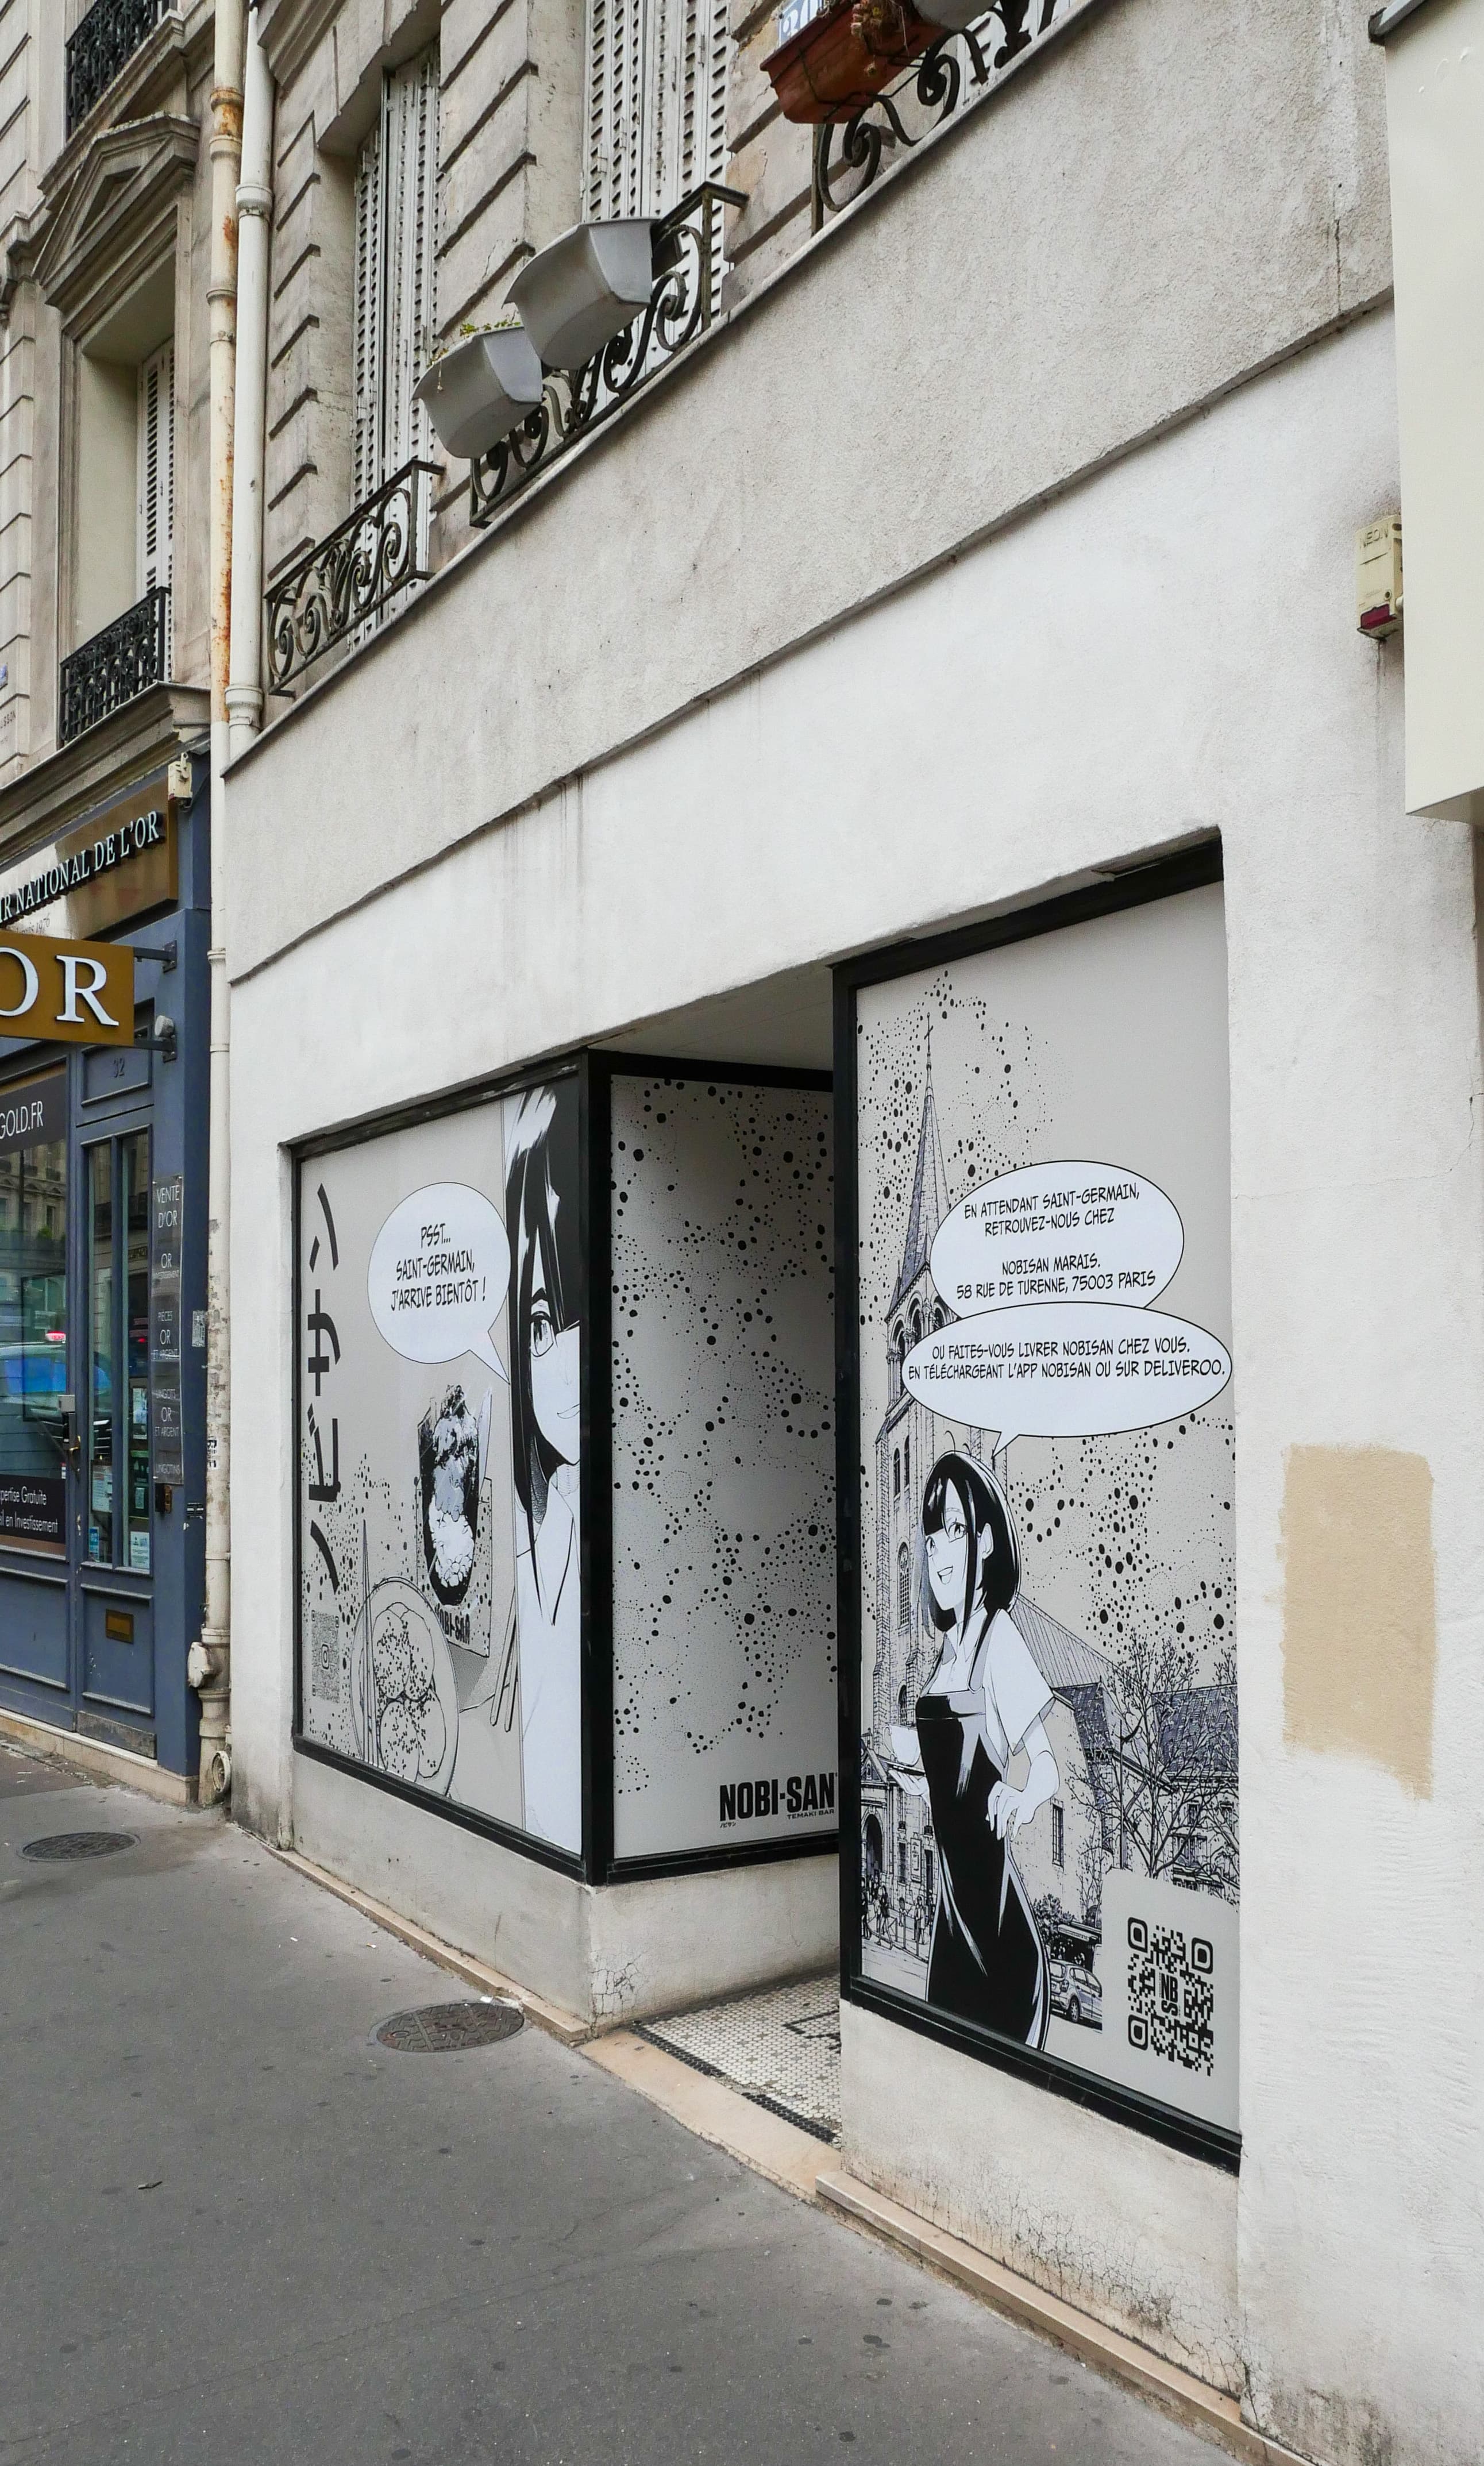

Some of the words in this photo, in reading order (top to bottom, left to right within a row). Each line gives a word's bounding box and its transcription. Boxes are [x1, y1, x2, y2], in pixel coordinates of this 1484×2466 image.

[16, 850, 90, 912] NATIONAL
[94, 834, 115, 872] DE
[120, 811, 160, 858] L'OR
[0, 946, 120, 1026] OR
[0, 1100, 44, 1139] GOLD.FR
[157, 1185, 180, 1204] VENTE
[965, 1204, 977, 1219] EN
[981, 1196, 1039, 1217] ATTENDANT
[1043, 1182, 1139, 1209] SAINT-GERMAIN,
[158, 1210, 178, 1228] D'OR
[985, 1211, 1080, 1237] RETROUVEZ-NOUS
[1084, 1207, 1115, 1226] CHEZ
[421, 1223, 451, 1249] PSST...
[161, 1253, 172, 1269] OR
[396, 1249, 475, 1281] SAINT-GERMAIN,
[1002, 1257, 1049, 1276] NOBISAN
[1053, 1253, 1101, 1273] MARAIS.
[391, 1286, 432, 1311] J'ARRIVE
[435, 1278, 479, 1306] BIENTÔT
[482, 1276, 486, 1301] !
[957, 1284, 972, 1300] 58
[976, 1282, 995, 1298] RUE
[999, 1281, 1014, 1296] DE
[1017, 1277, 1068, 1296] TURENNE,
[1072, 1273, 1113, 1292] 75003
[1118, 1270, 1156, 1289] PARIS
[160, 1329, 171, 1344] OR
[932, 1344, 945, 1360] OU
[949, 1342, 1015, 1360] FAITES-VOUS
[1018, 1341, 1058, 1358] LIVRER
[1062, 1339, 1114, 1357] NOBISAN
[1118, 1338, 1150, 1355] CHEZ
[1154, 1336, 1190, 1354] VOUS.
[908, 1365, 920, 1380] EN
[924, 1363, 1004, 1380] TÉLÉCHARGEANT
[1008, 1362, 1038, 1379] L'APP
[1042, 1361, 1091, 1378] NOBISAN
[1095, 1360, 1111, 1377] OU
[1115, 1359, 1139, 1377] SUR
[1144, 1359, 1225, 1377] DELIVEROO.
[161, 1407, 172, 1422] OR
[21, 1486, 47, 1505] Gratuite
[5, 1516, 13, 1527] en
[15, 1511, 58, 1533] Investissement
[787, 1811, 816, 1820] TEMAKI
[818, 1809, 835, 1817] BAR
